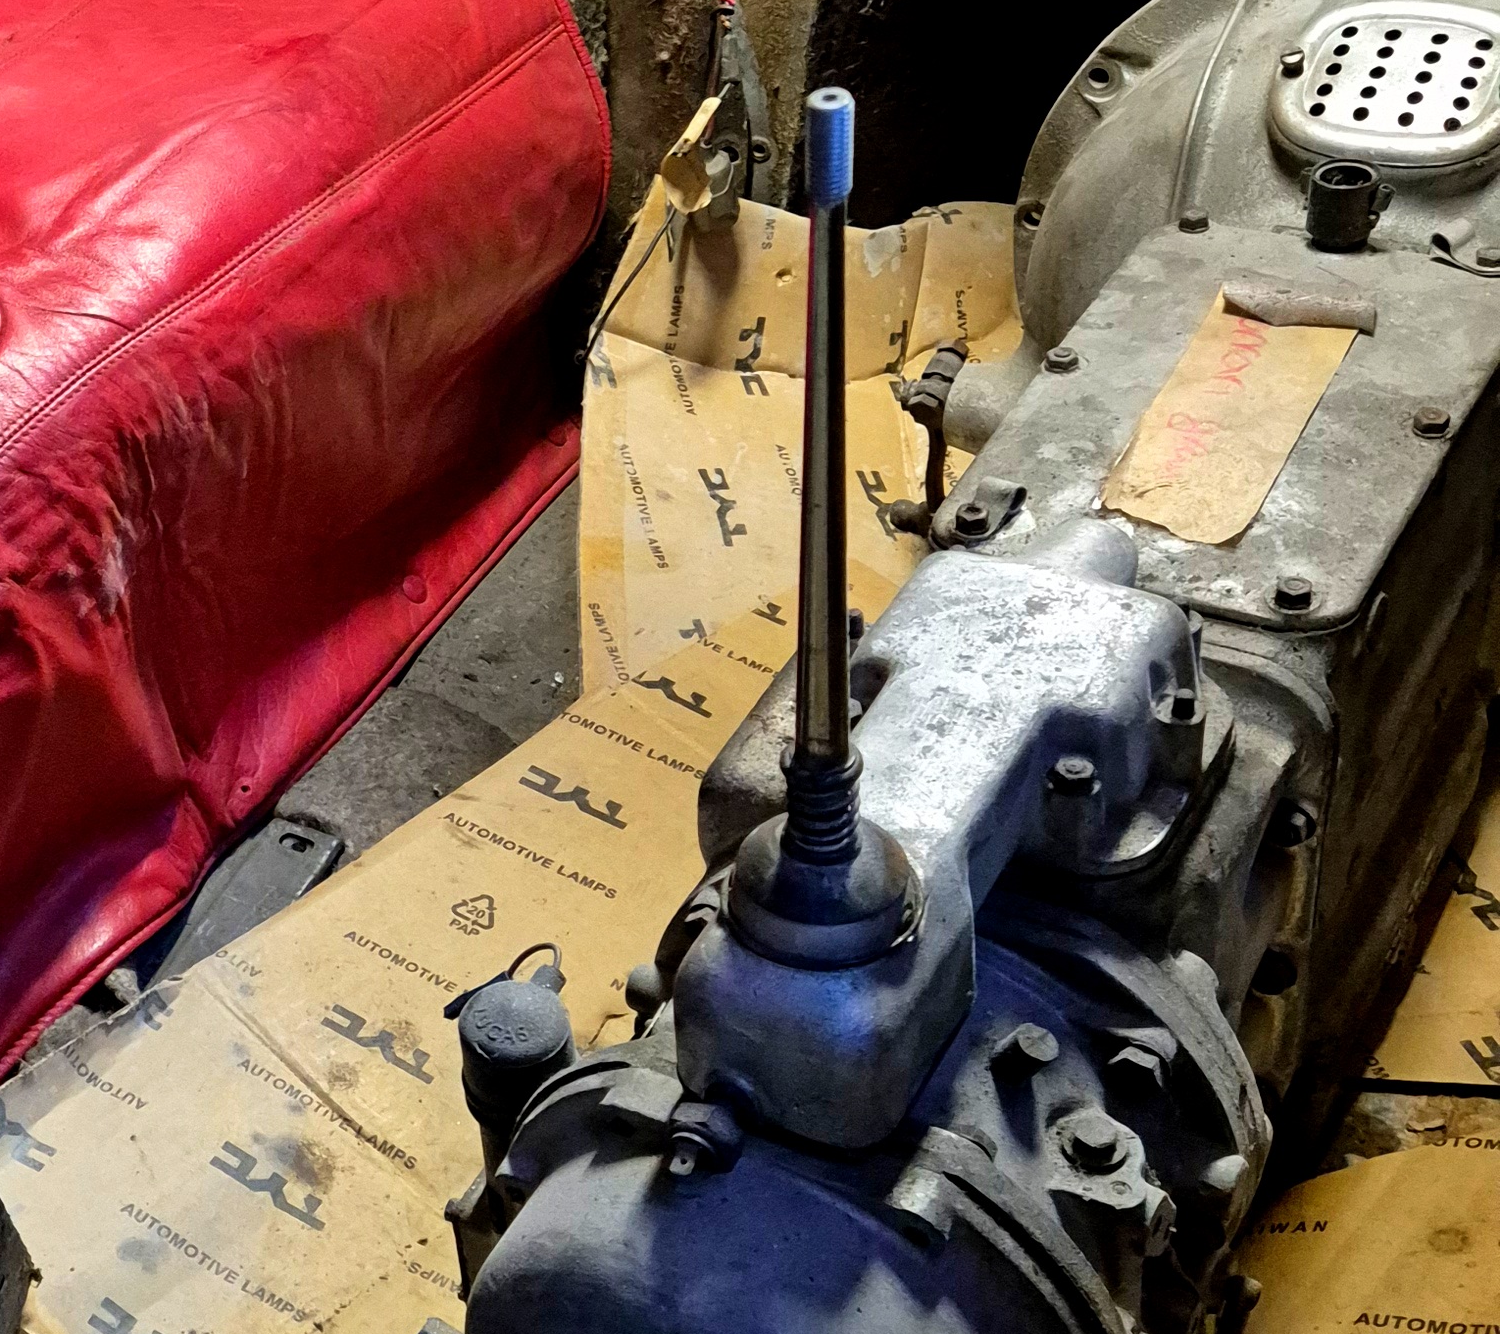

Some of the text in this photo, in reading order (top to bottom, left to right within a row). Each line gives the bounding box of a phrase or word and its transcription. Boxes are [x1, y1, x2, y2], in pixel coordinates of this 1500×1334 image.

[668, 285, 685, 337] LAMPS
[619, 443, 652, 525] AUTOMOTIVE
[588, 602, 614, 643] LAMPS
[646, 747, 706, 781] LAMPS
[443, 812, 618, 900] AUTOMOTIVE LAMPS
[449, 917, 480, 937] PAP
[465, 903, 487, 920] 20
[343, 931, 458, 993] AUTOMOTIVE
[237, 1058, 418, 1170] AUTOMOTIVE LAMPS
[120, 1203, 309, 1323] AUTOMOTIVE LAMPS
[408, 1260, 462, 1294] AMPS
